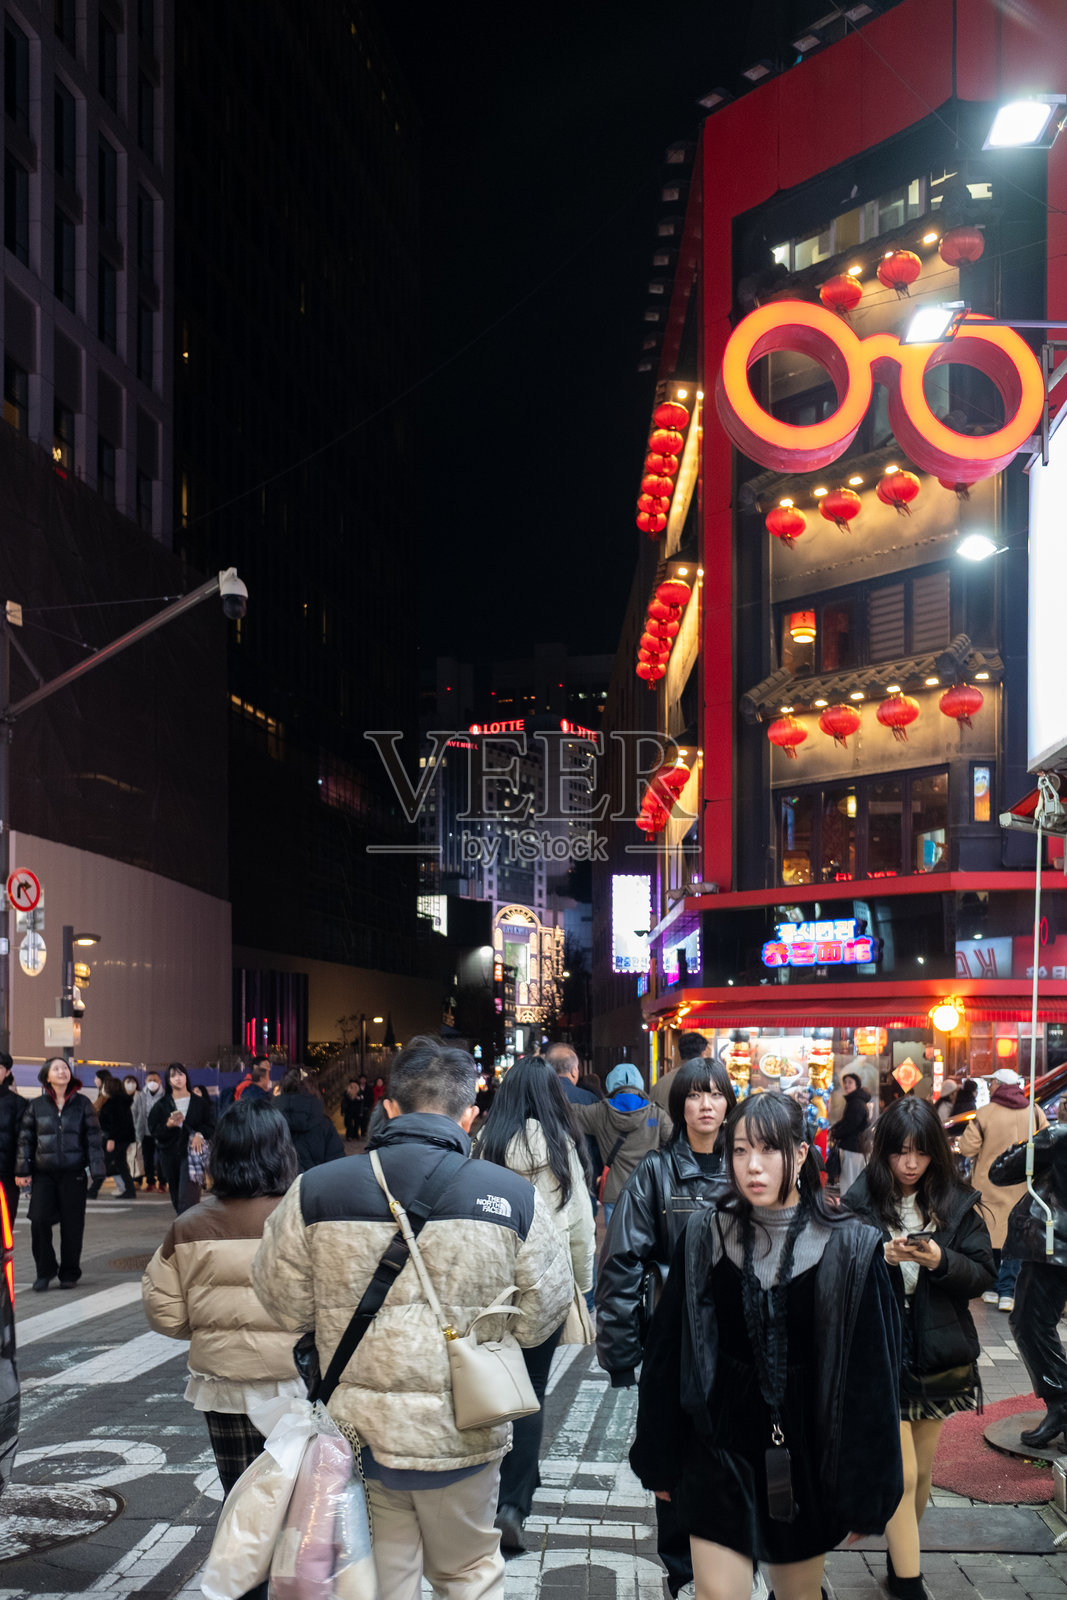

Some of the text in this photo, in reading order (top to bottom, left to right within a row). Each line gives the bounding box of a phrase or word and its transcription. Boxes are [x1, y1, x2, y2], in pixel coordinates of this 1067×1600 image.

[483, 719, 525, 734] LOTTE
[487, 1194, 502, 1202] THE
[476, 1198, 502, 1210] NORTH
[482, 1205, 503, 1216] FACE
